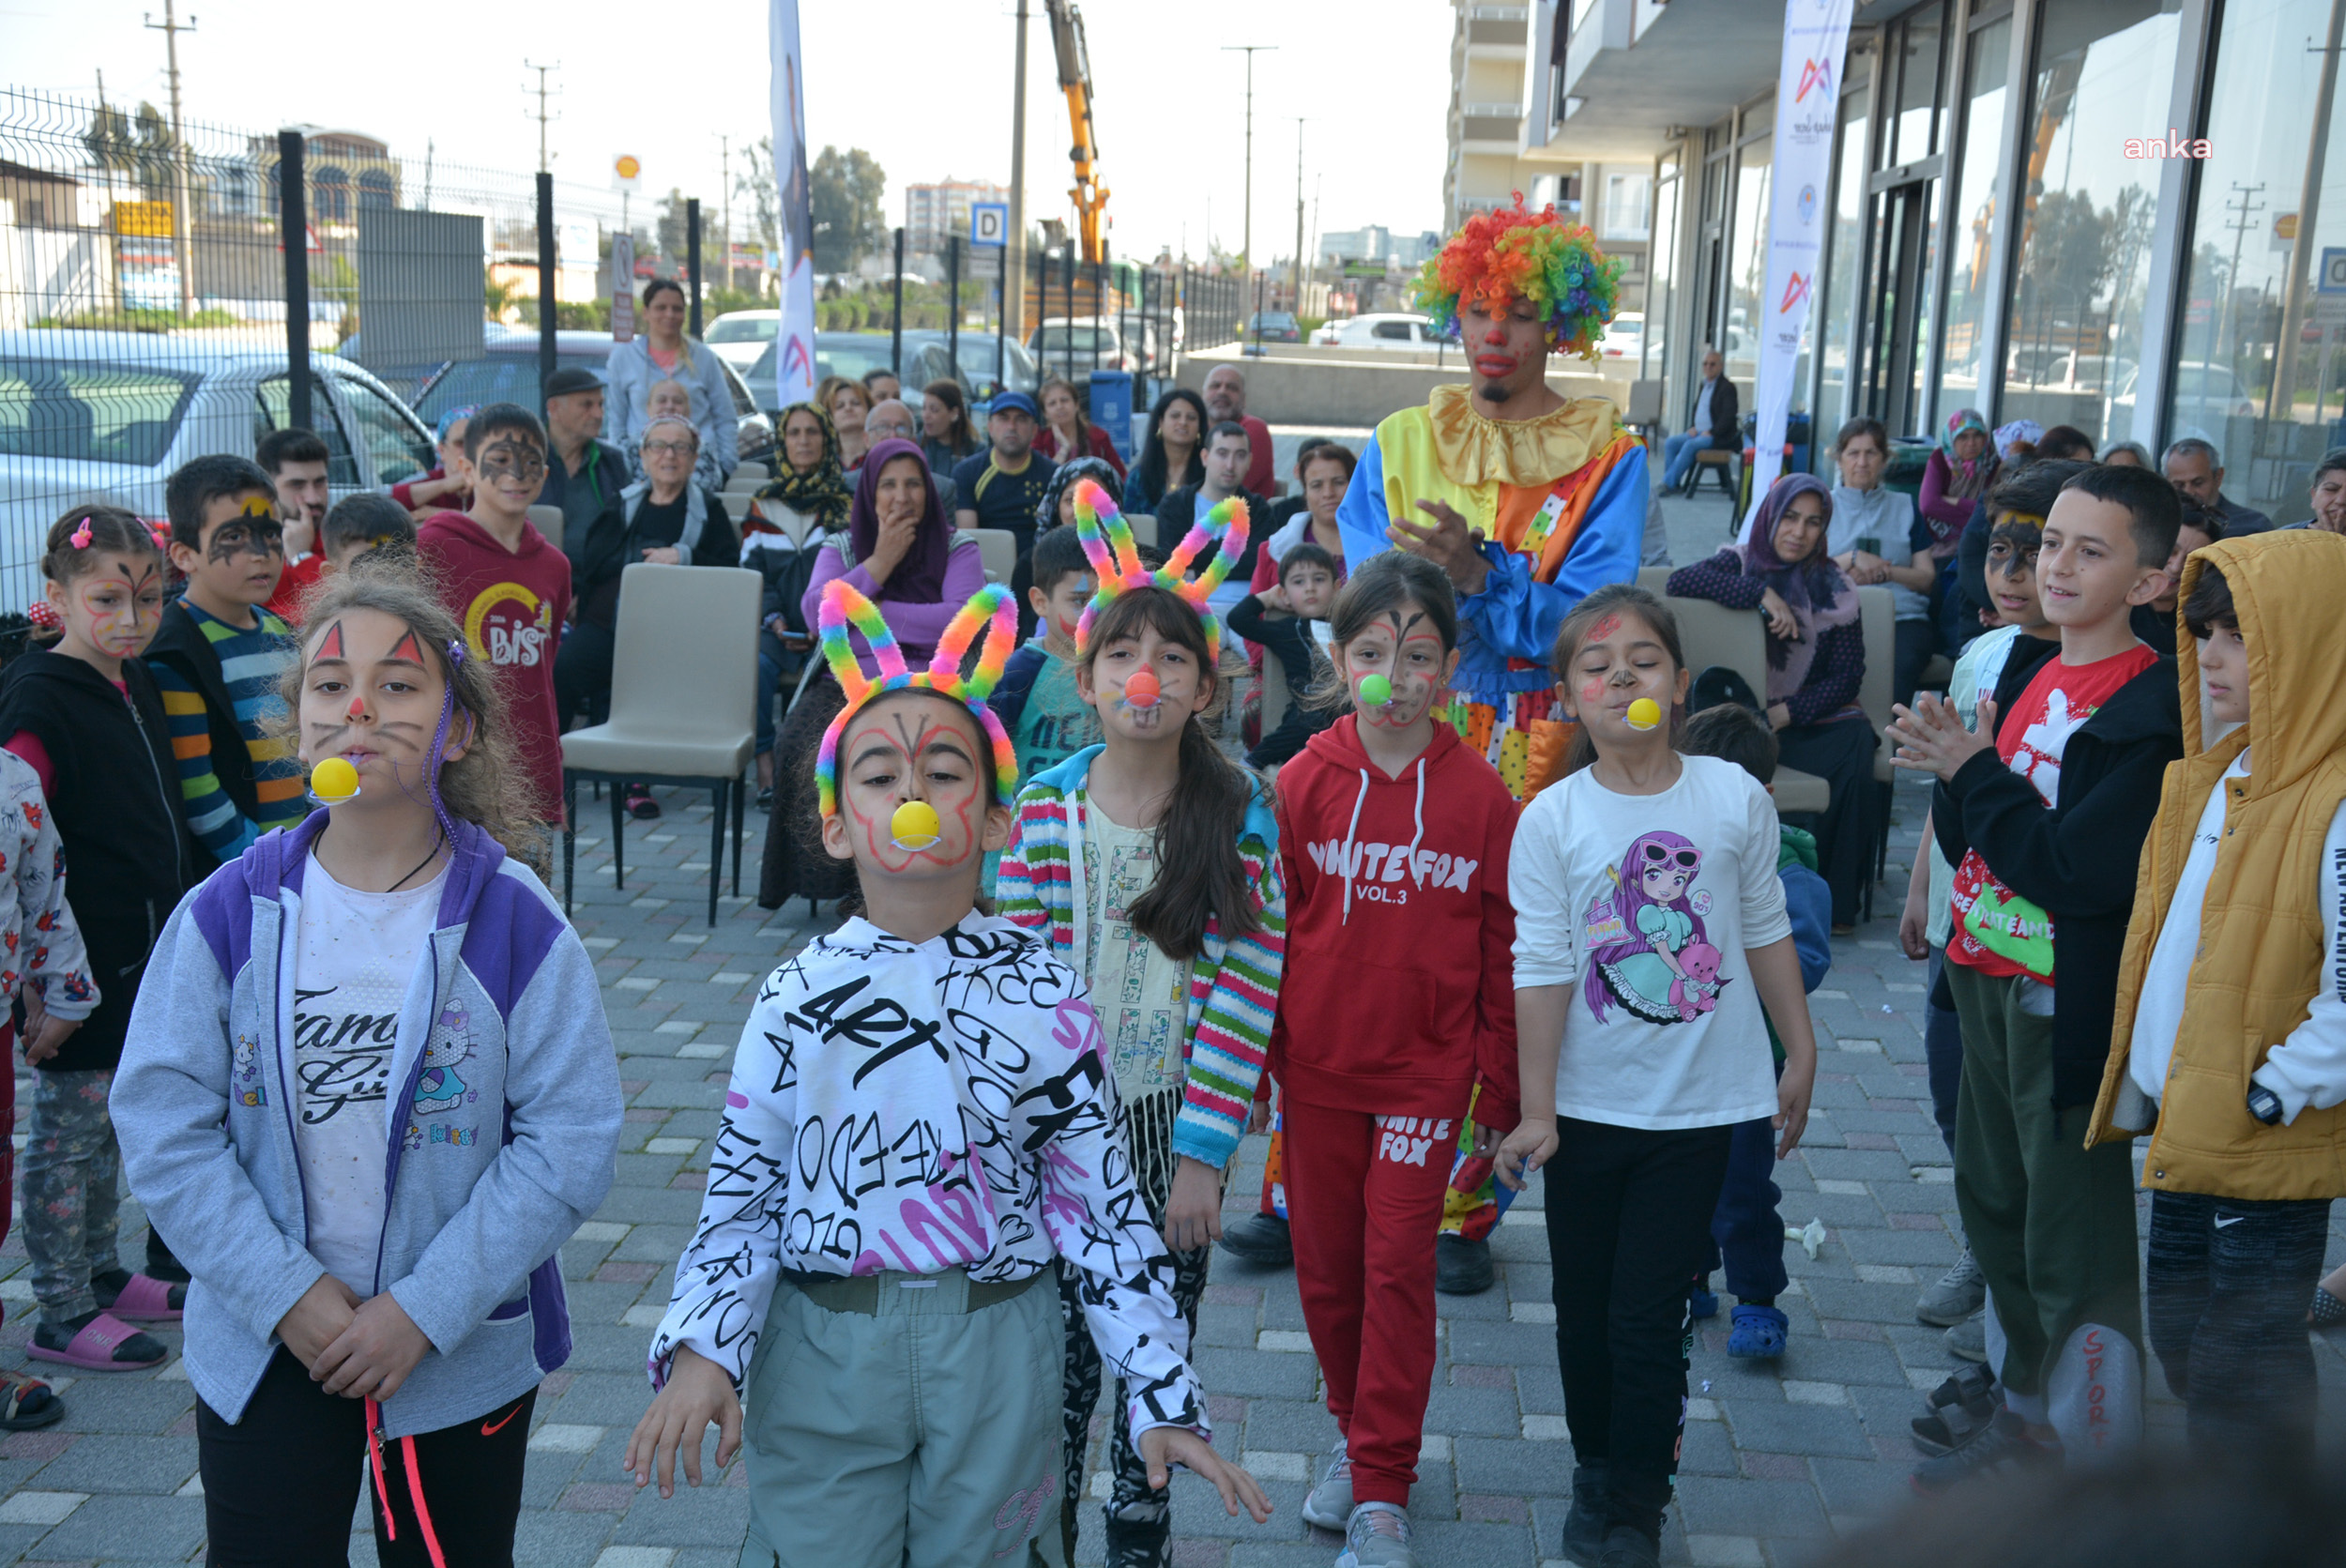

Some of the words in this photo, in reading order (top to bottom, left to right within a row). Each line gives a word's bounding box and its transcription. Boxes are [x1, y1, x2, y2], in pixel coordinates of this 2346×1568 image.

[982, 213, 998, 236] D
[1307, 838, 1409, 883] WHITE
[1415, 849, 1478, 893] FOX
[1356, 885, 1407, 905] VOL.3
[1379, 1131, 1433, 1167] FOX
[2083, 1330, 2110, 1450] SPORT
